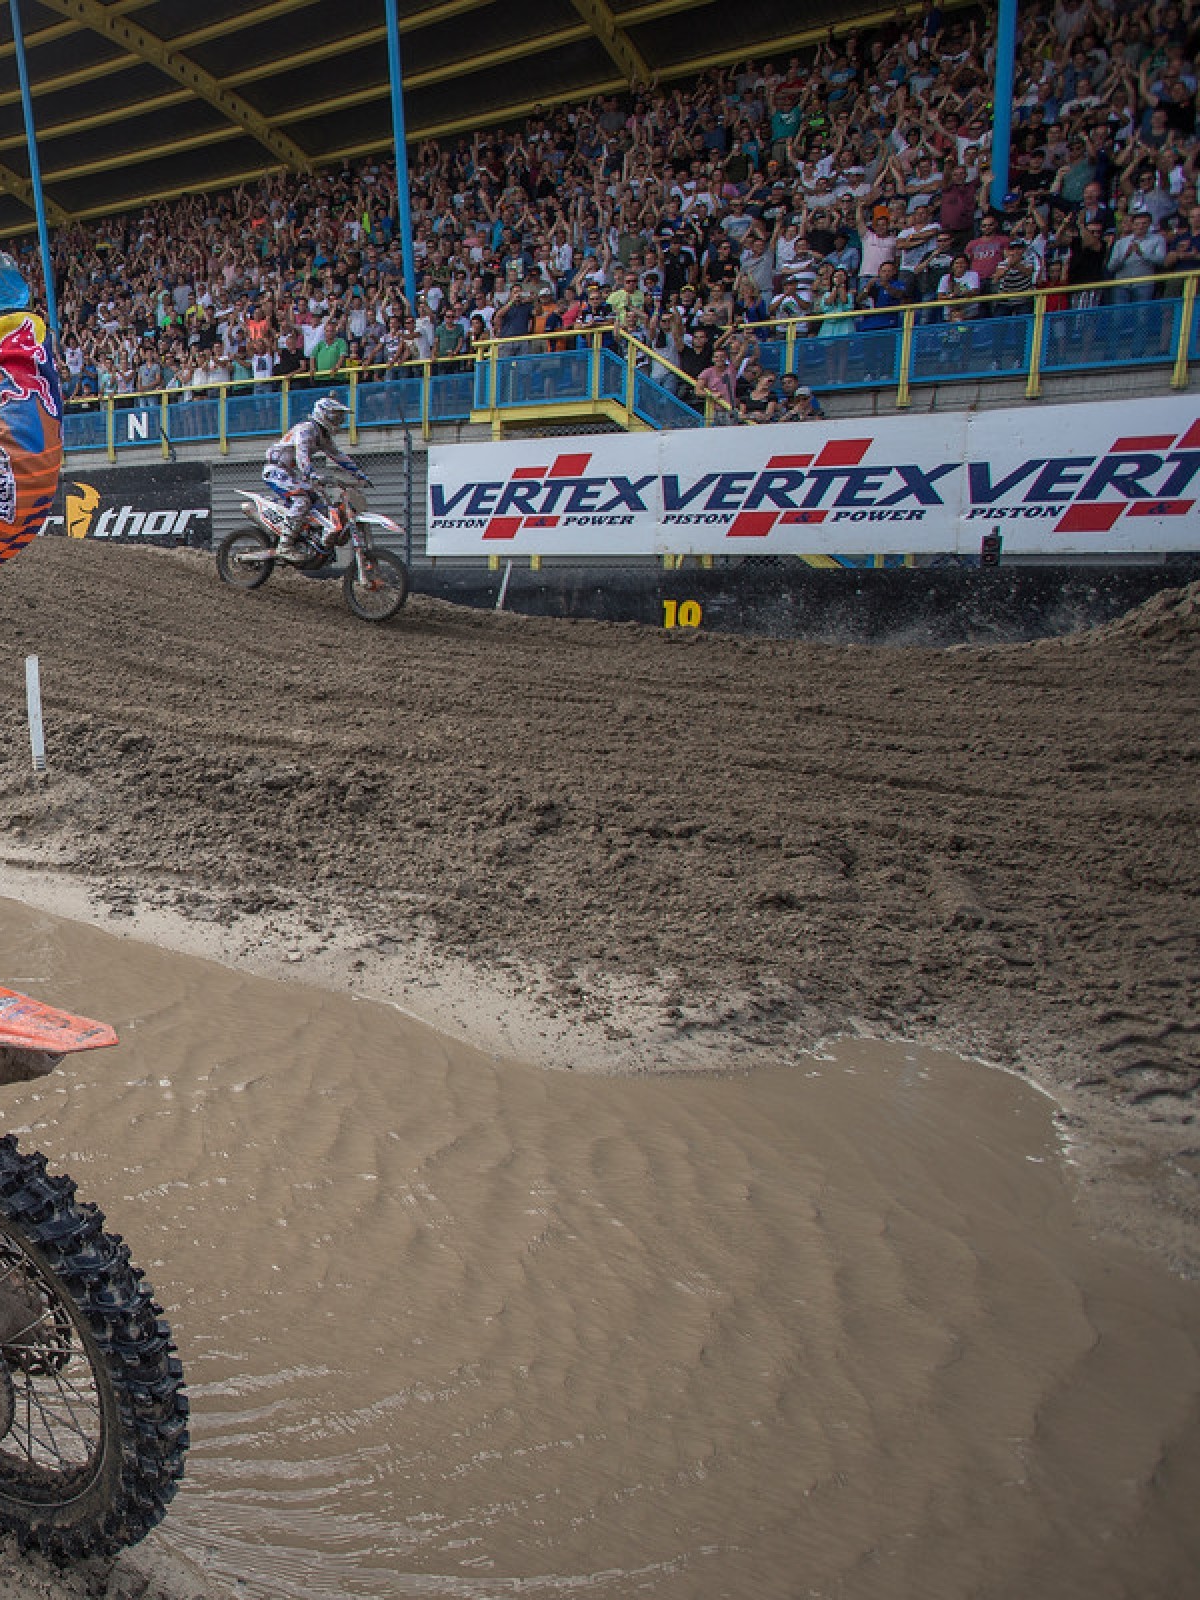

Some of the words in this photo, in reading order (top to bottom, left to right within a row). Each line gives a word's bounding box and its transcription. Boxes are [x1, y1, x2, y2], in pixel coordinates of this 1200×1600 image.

[128, 413, 149, 440] N
[431, 475, 658, 517] VERTEX
[661, 464, 964, 511] VERTEX
[94, 505, 209, 537] thor
[431, 517, 488, 529] PISTON
[562, 515, 635, 527] POWER
[661, 513, 736, 525] PISTON
[831, 509, 927, 523] POWER
[965, 505, 1065, 520] PISTON
[662, 599, 703, 629] 10
